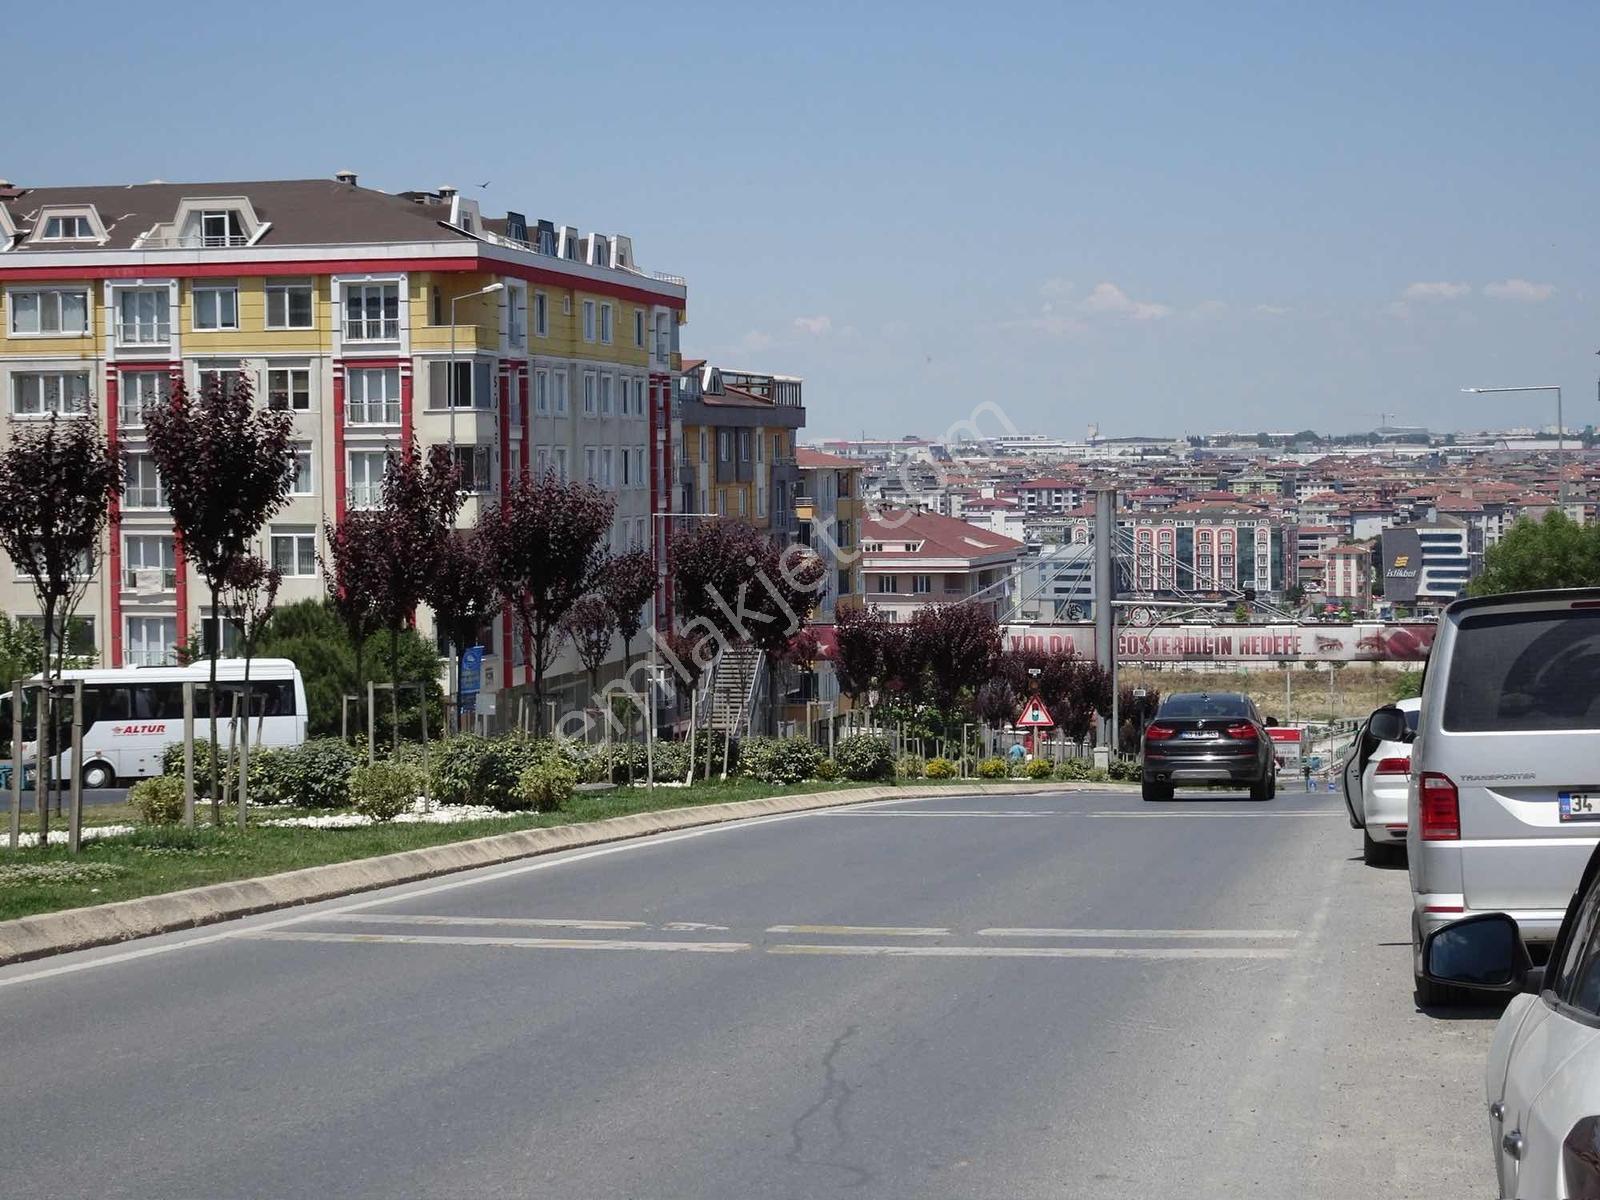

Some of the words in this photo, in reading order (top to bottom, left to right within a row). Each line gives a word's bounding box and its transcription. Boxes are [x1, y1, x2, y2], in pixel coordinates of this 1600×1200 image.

[123, 725, 166, 733] ALTUR
[1460, 773, 1536, 781] TRANSPORTER
[1571, 794, 1593, 812] 34
